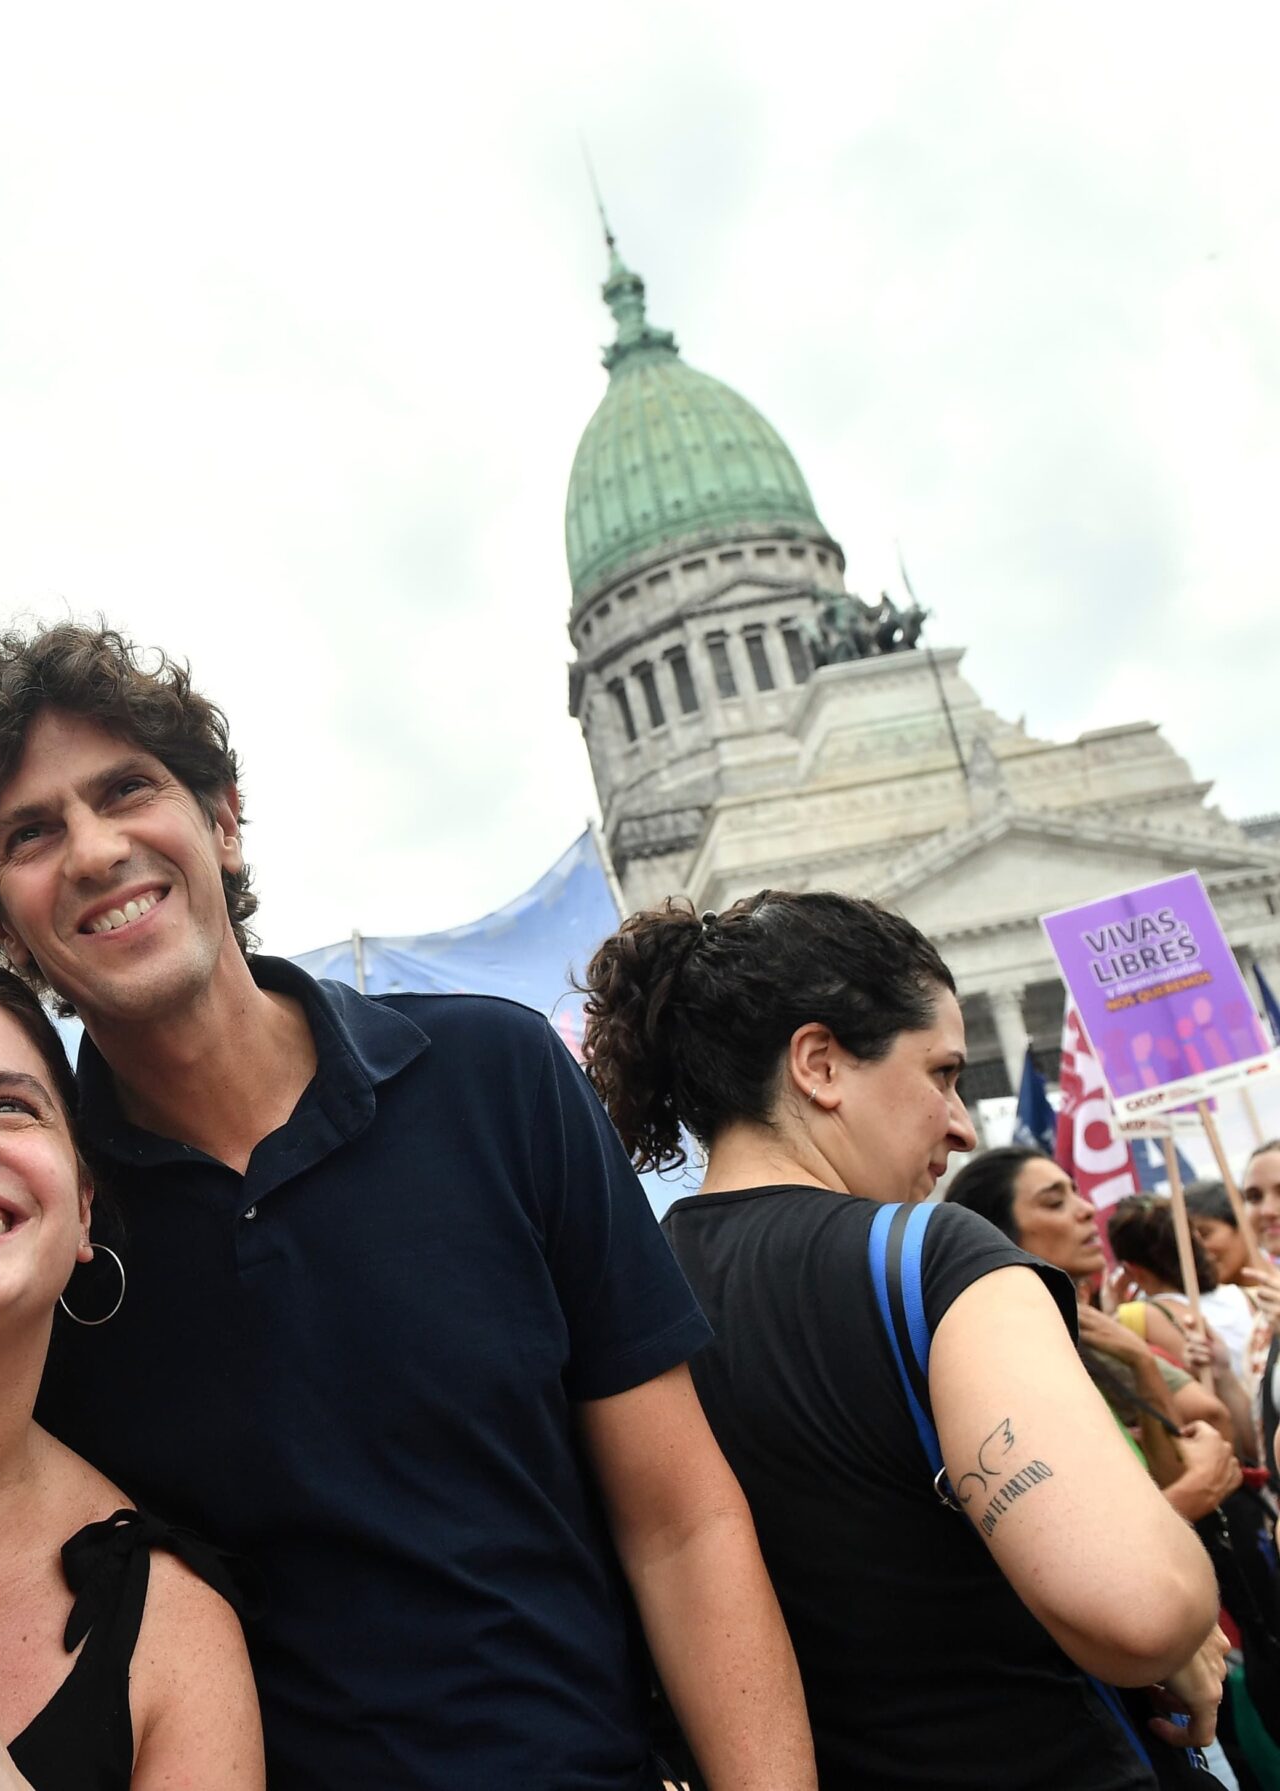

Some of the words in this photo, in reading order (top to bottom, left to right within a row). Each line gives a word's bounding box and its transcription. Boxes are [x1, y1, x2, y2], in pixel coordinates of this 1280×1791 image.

[1092, 935, 1197, 983] LIBRES
[979, 1508, 998, 1538] CON
[992, 1496, 1008, 1516] TE
